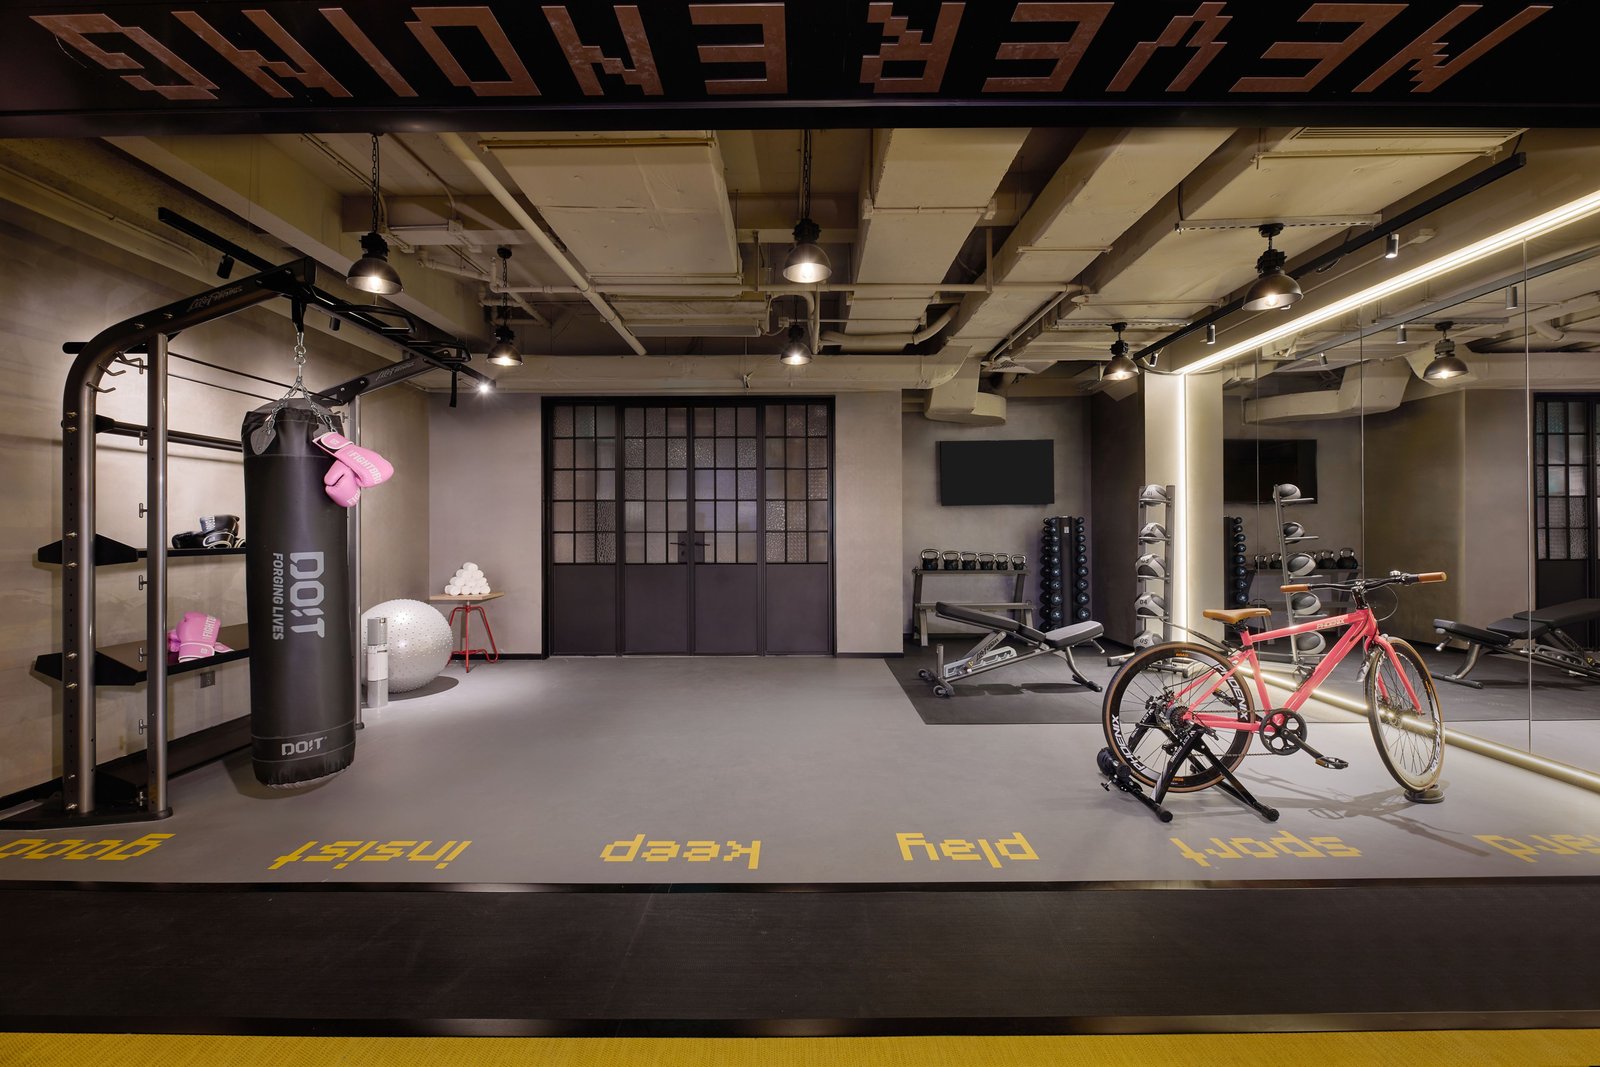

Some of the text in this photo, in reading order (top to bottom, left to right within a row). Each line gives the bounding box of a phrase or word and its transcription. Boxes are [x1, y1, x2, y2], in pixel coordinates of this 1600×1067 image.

[29, 3, 1553, 102] NEVER ENDING
[272, 552, 284, 640] FORGING LIVES
[1139, 637, 1149, 645] 05
[1111, 714, 1146, 771] PHOENIX
[267, 839, 473, 871] insist
[601, 834, 762, 870] keep
[895, 832, 1040, 870] play
[1172, 831, 1361, 867] sport
[1472, 834, 1600, 863] ard
